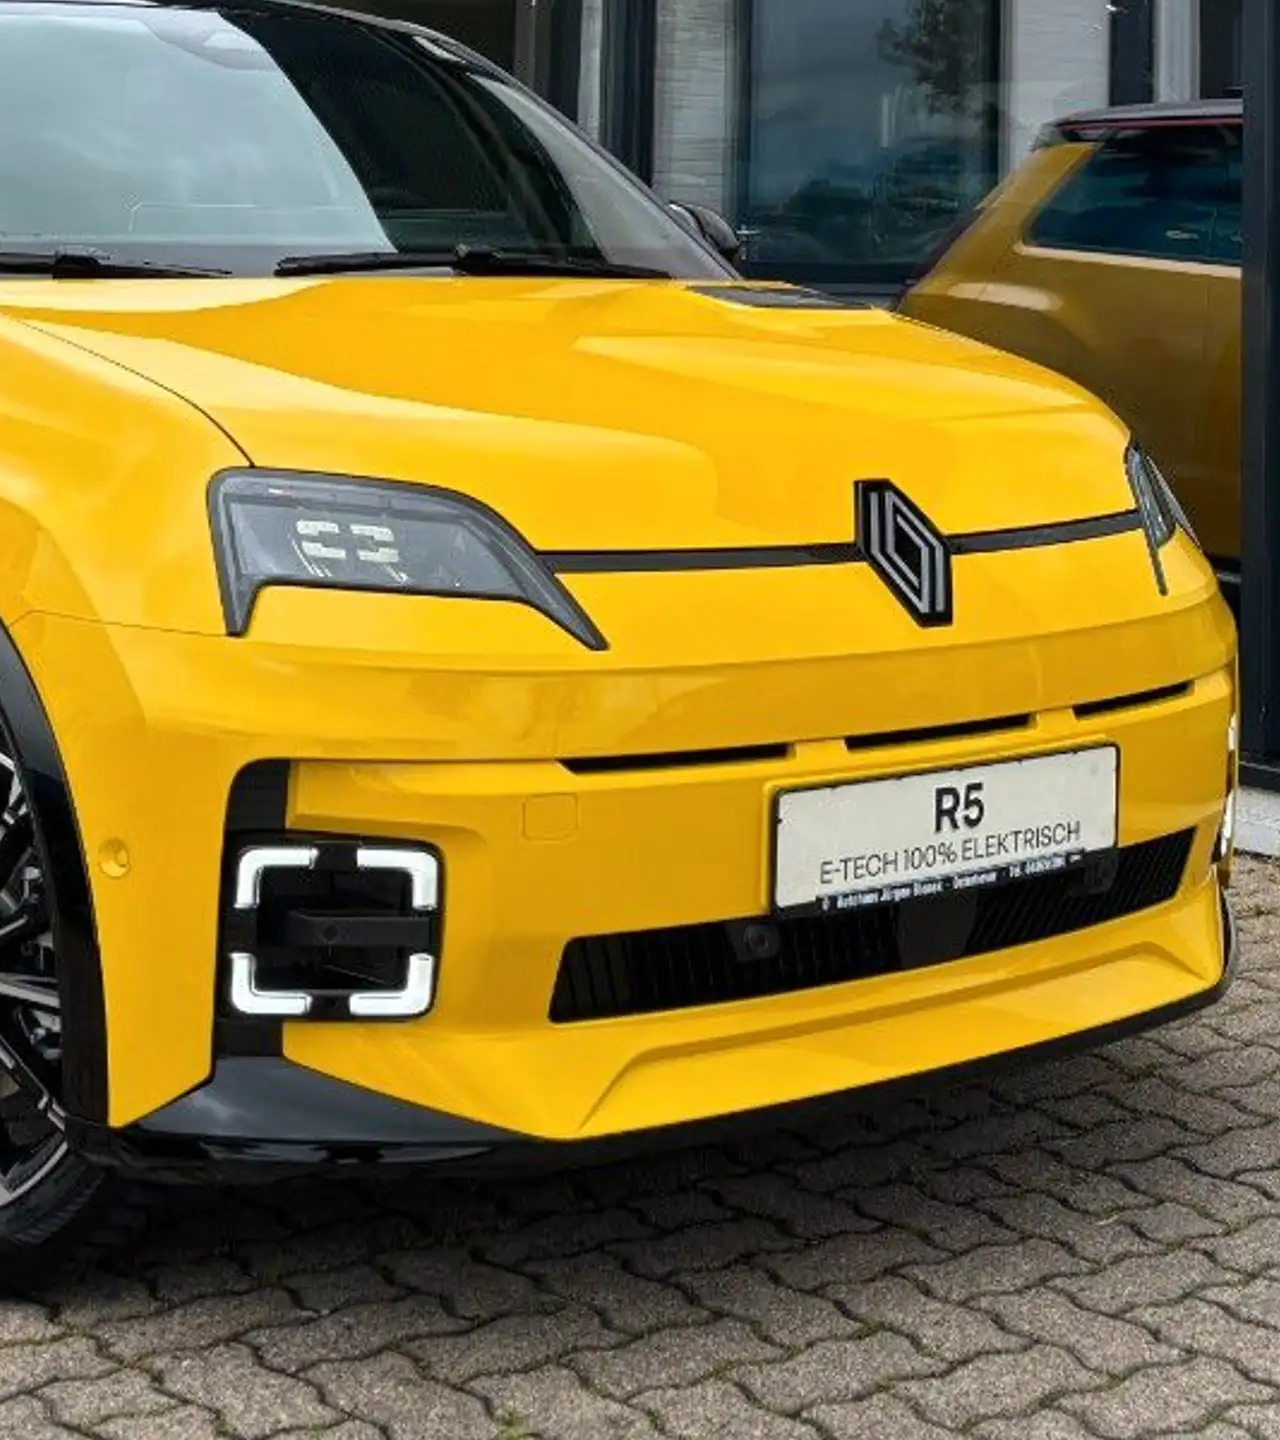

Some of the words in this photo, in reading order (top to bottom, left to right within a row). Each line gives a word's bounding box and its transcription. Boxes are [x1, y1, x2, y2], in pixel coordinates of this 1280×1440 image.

[934, 782, 985, 834] R5
[820, 851, 899, 885] E-TECH
[903, 841, 958, 871] 100%
[961, 820, 1081, 861] ELEKTRISCH
